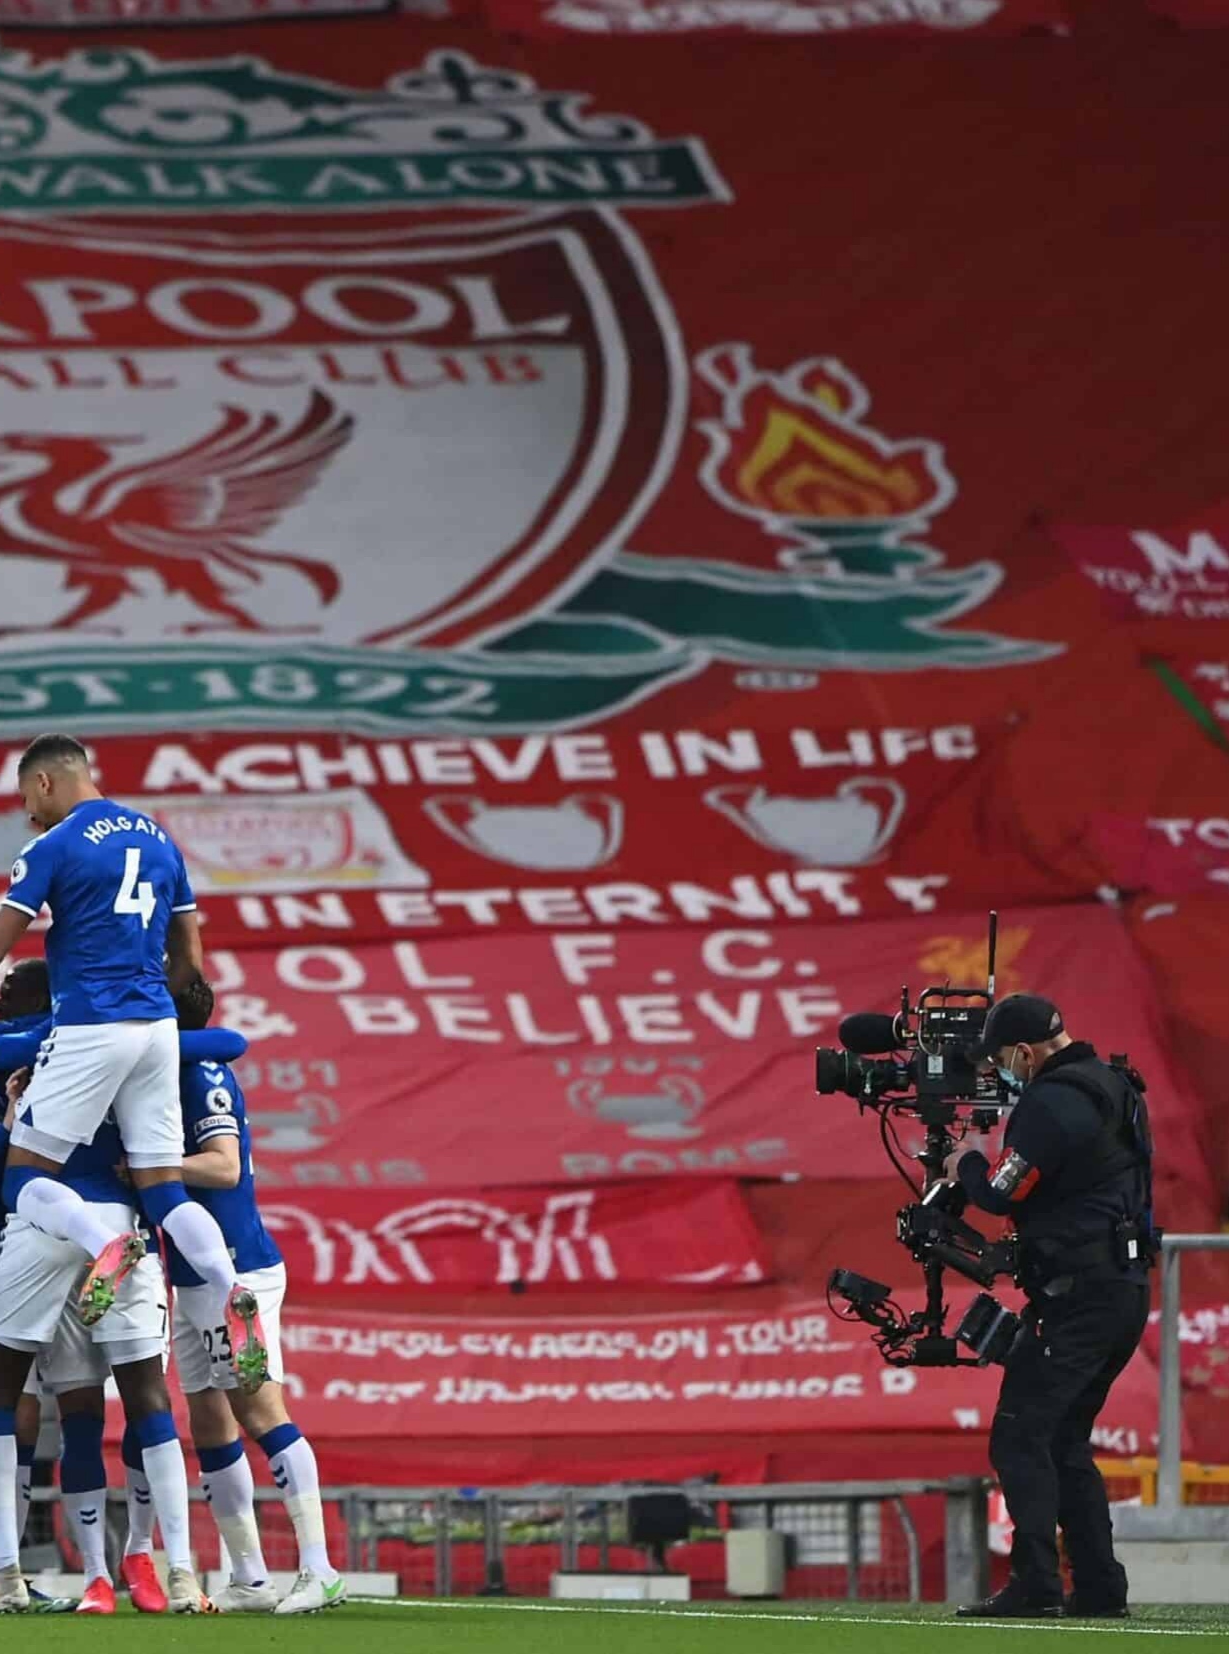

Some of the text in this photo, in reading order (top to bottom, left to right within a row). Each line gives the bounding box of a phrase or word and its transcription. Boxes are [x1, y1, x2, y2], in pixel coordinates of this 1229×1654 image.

[302, 154, 677, 195] ALONE
[216, 347, 546, 389] CLUB
[143, 732, 616, 793] ACHIEVE
[639, 728, 763, 778] IN
[113, 847, 157, 930] 4
[224, 892, 352, 931] IN
[337, 985, 842, 1045] BELIEVE
